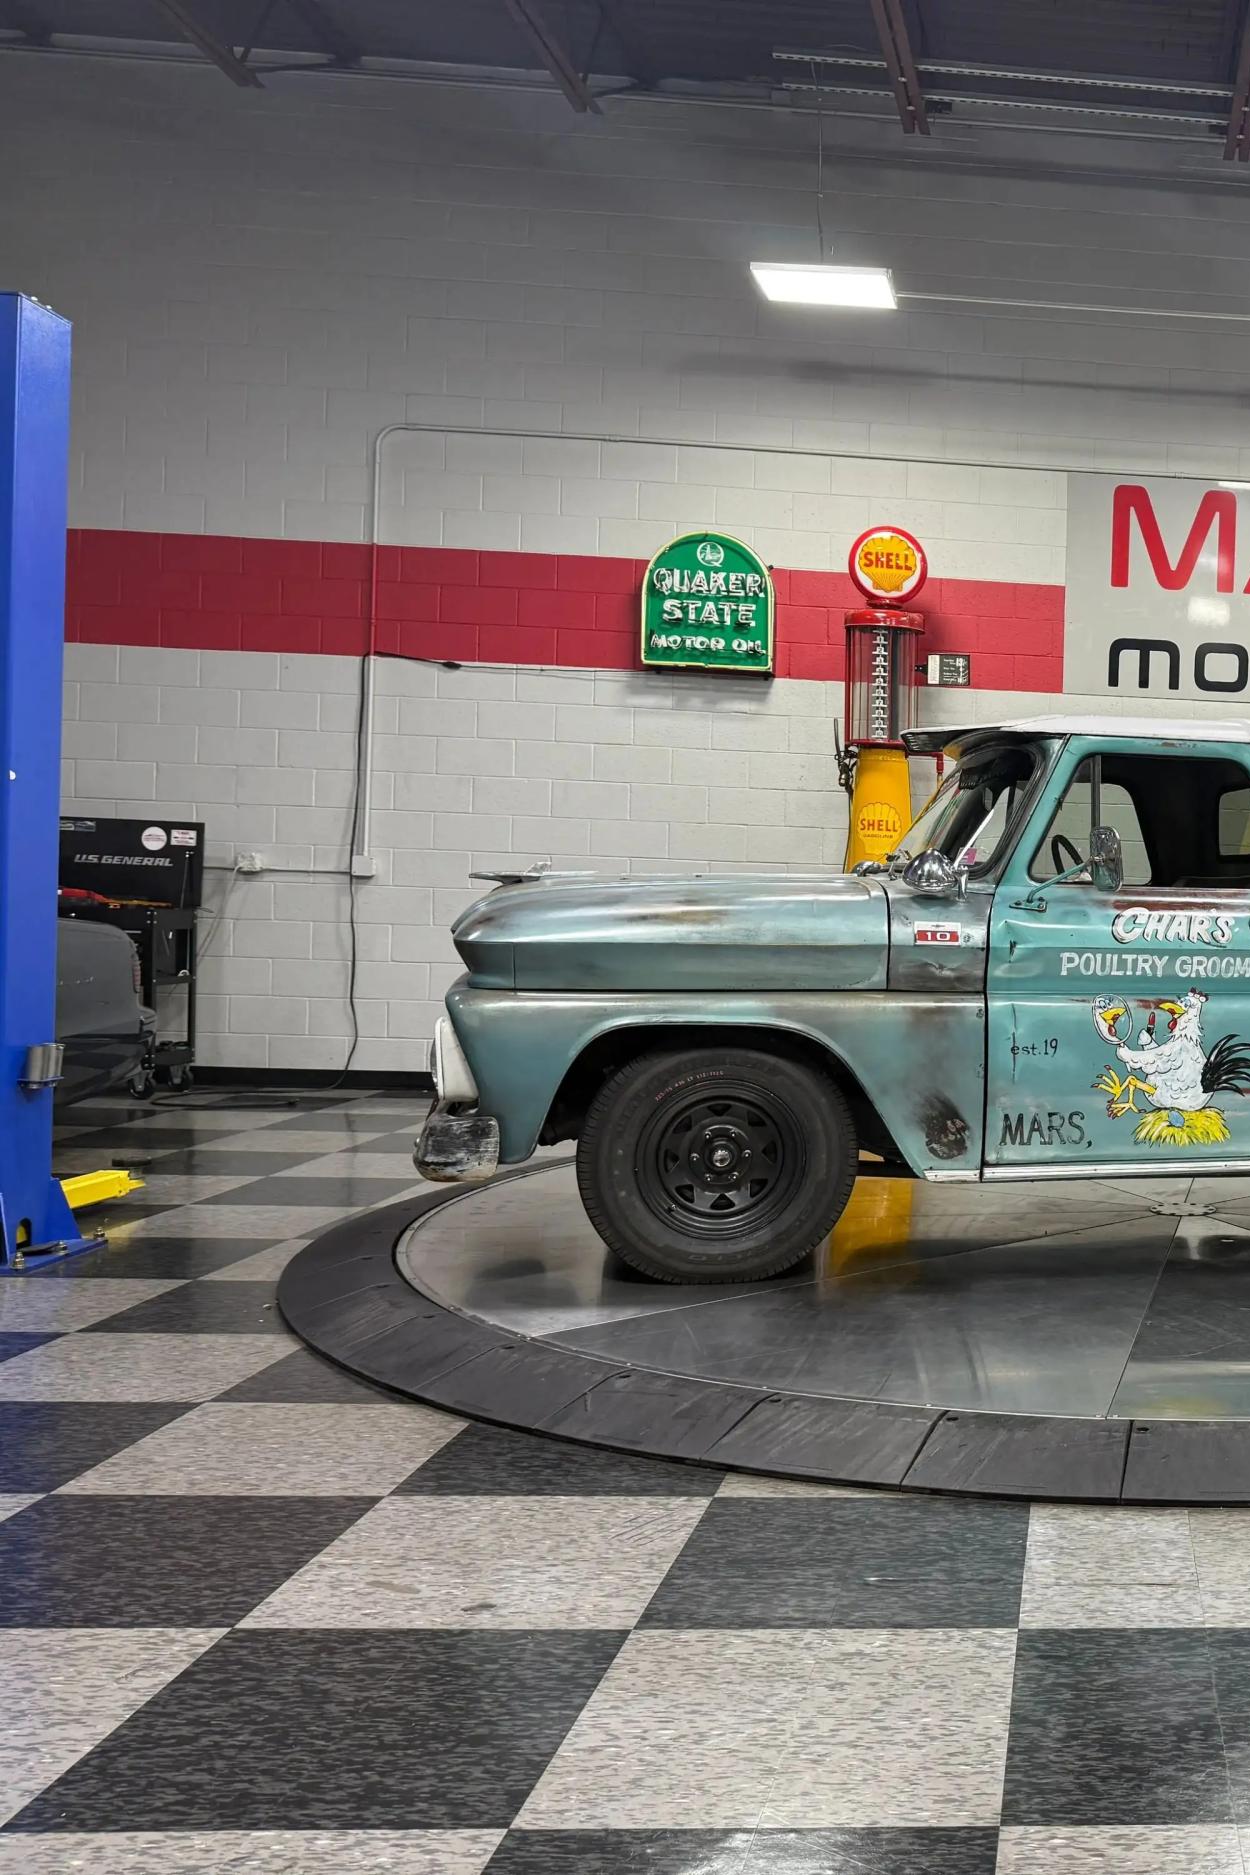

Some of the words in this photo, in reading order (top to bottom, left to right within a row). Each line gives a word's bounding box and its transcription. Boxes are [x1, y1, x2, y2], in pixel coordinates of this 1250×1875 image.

[863, 551, 912, 571] SHELL
[653, 567, 765, 597] QUAKER
[662, 599, 756, 627] STATE
[651, 633, 726, 651] MOTOR
[860, 818, 898, 832] SHELL
[100, 855, 174, 867] GENERAL
[926, 931, 950, 941] 10
[1060, 952, 1169, 977] POULTRY
[999, 1111, 1092, 1148] MARS,
